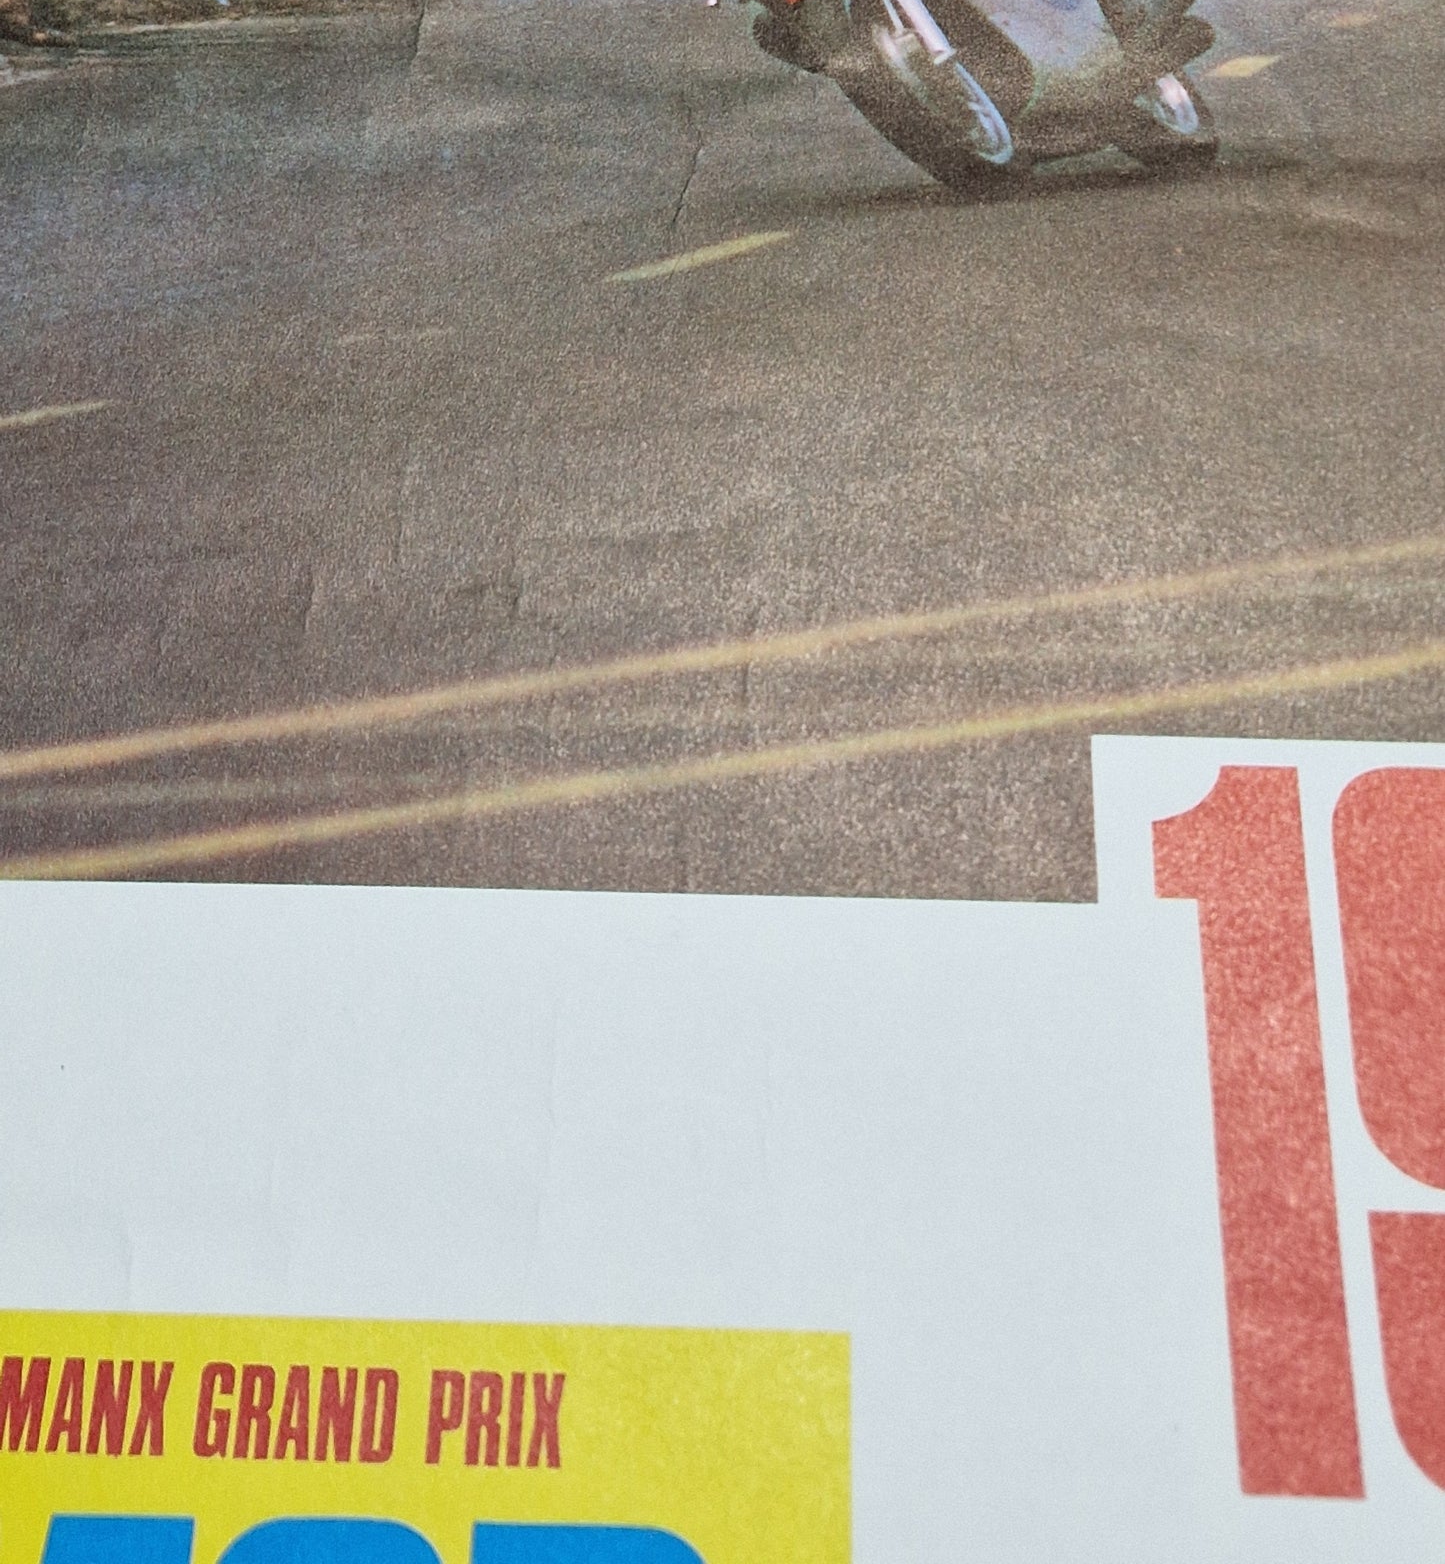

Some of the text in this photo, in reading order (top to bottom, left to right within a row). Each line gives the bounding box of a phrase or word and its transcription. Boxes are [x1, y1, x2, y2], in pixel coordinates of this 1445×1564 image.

[0, 1357, 564, 1468] MANX GRAND PRIX
